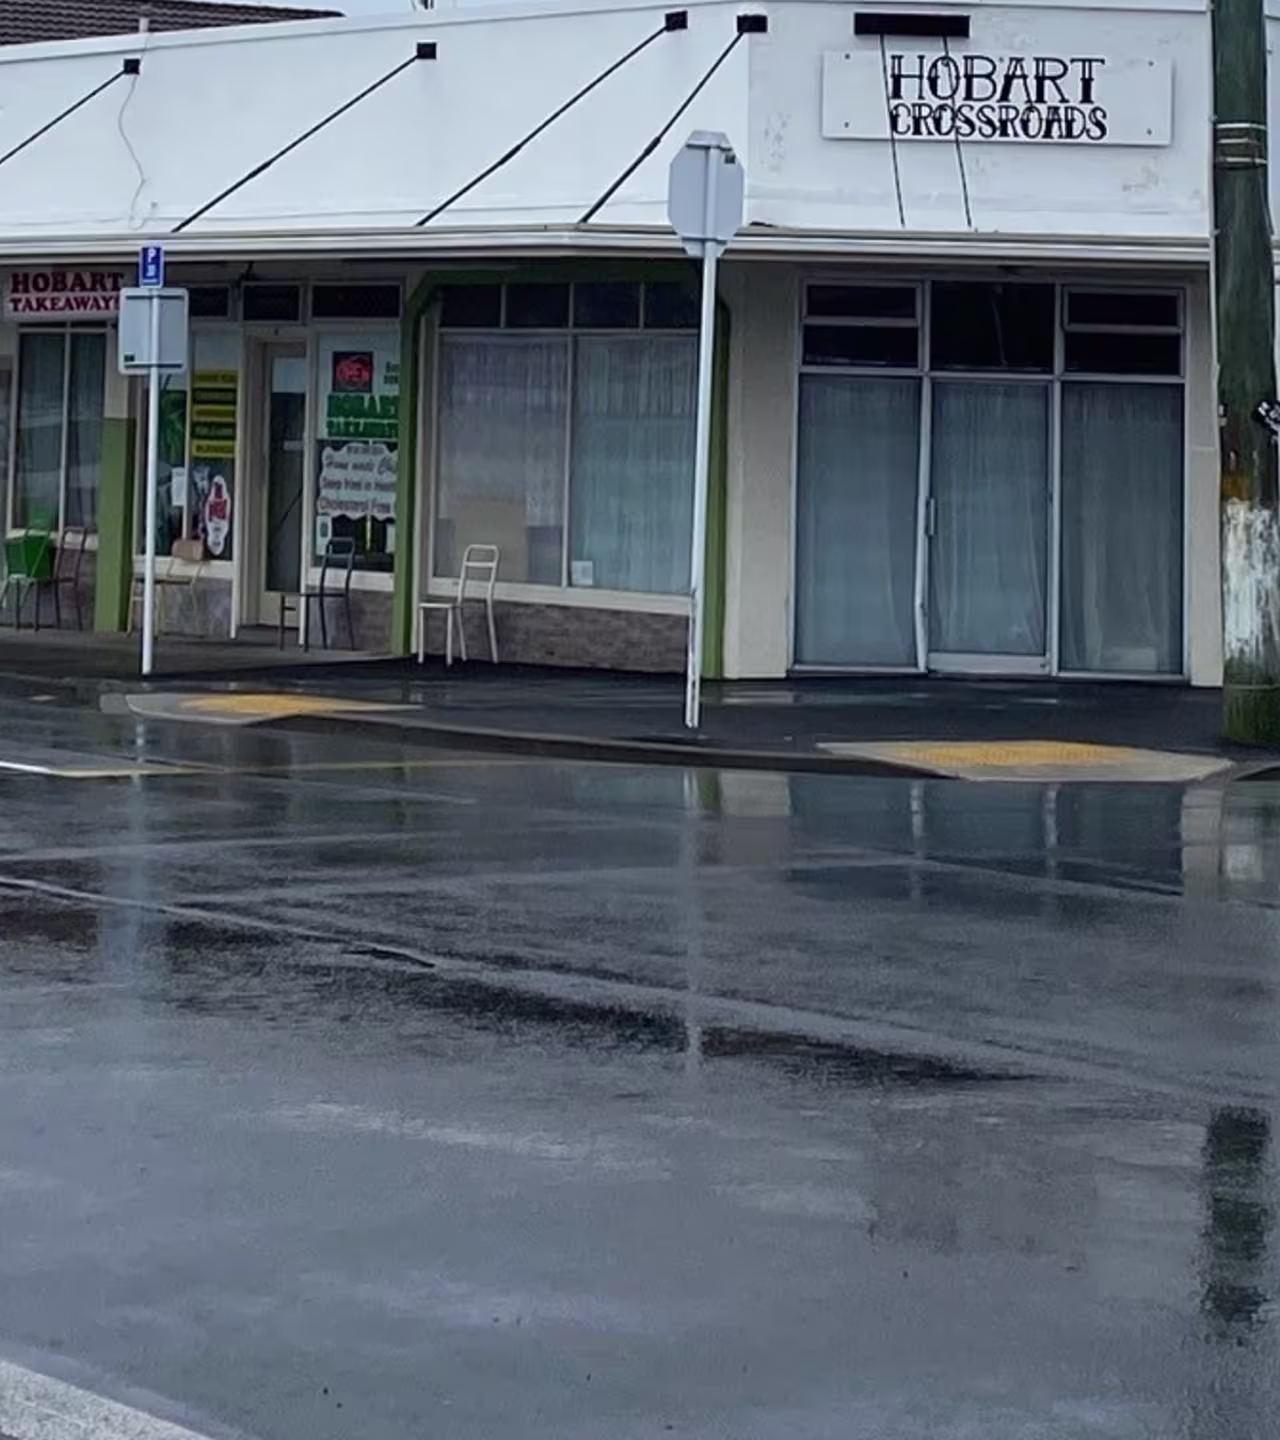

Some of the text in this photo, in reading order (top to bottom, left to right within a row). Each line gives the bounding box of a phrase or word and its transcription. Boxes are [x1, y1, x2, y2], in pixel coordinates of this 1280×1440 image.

[890, 55, 1105, 103] HOBART
[889, 103, 1107, 140] CROSSROADS
[10, 272, 124, 294] HOBART
